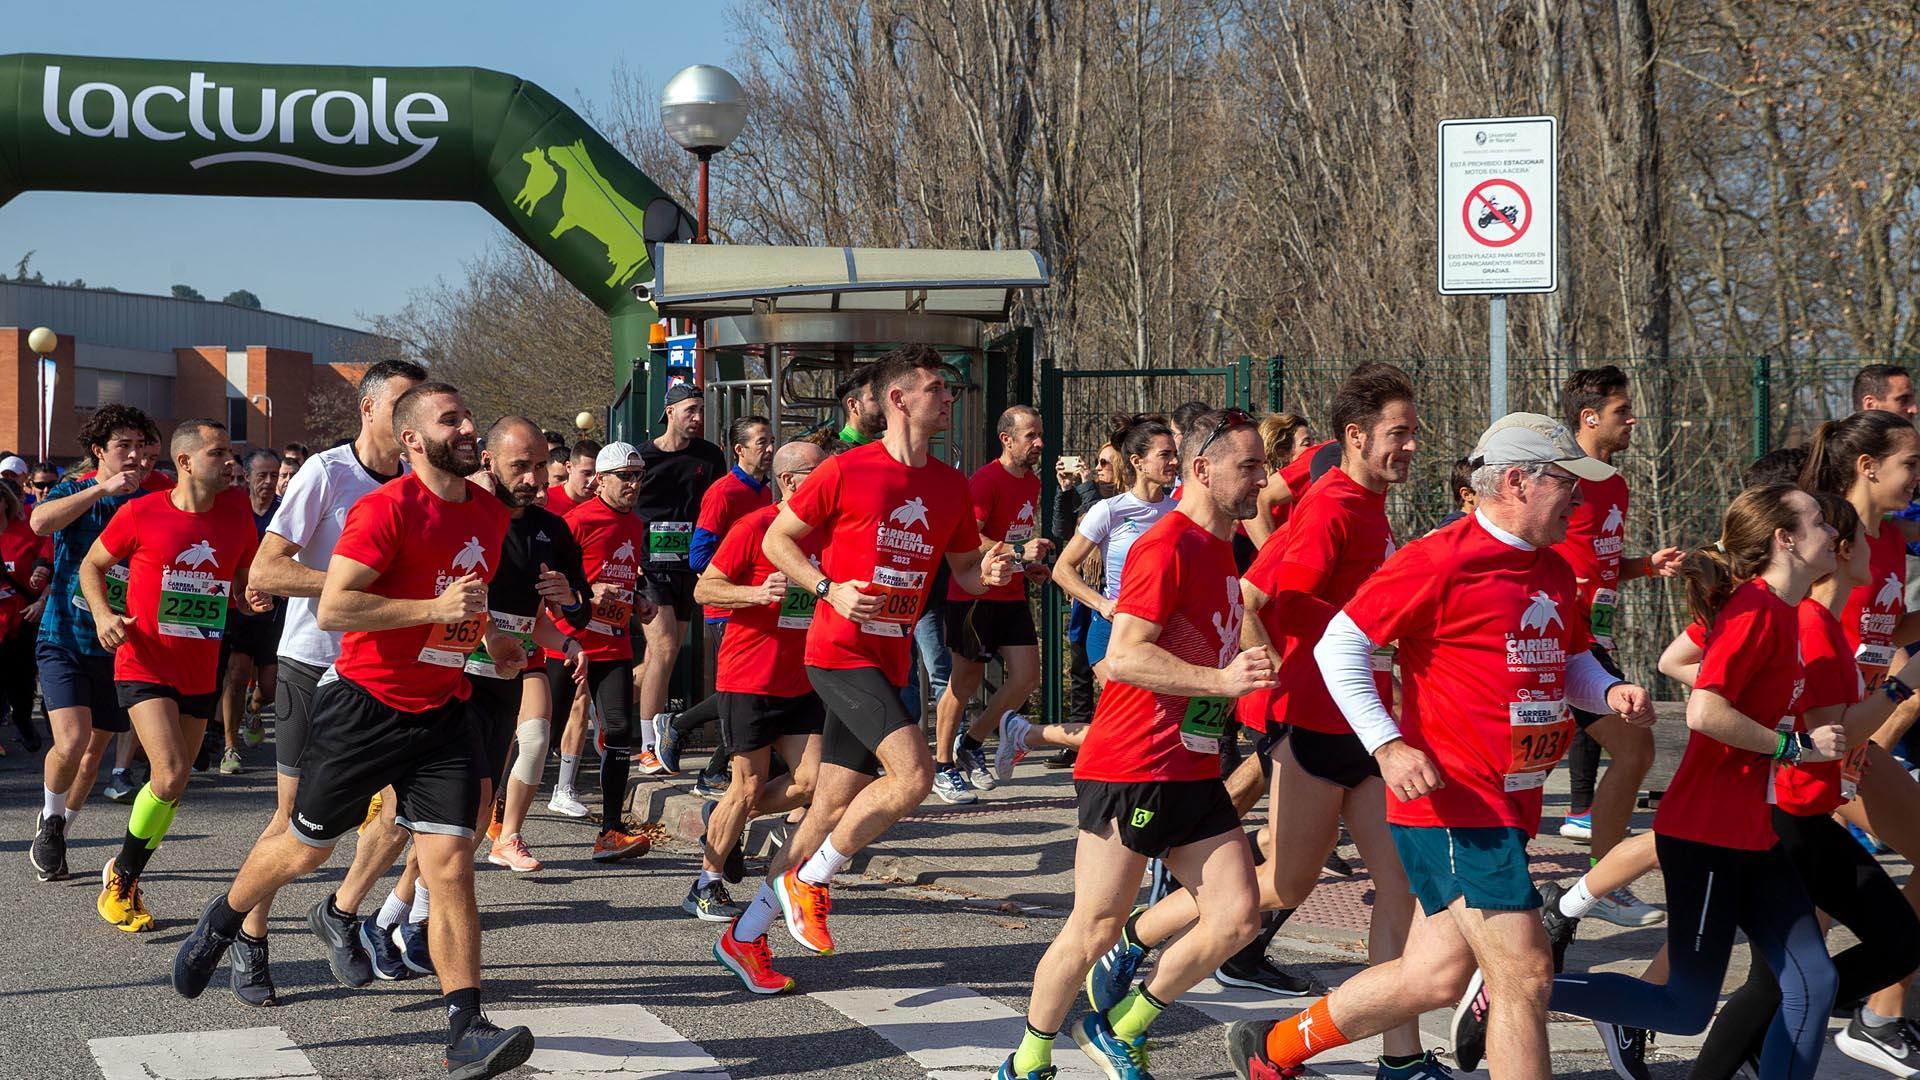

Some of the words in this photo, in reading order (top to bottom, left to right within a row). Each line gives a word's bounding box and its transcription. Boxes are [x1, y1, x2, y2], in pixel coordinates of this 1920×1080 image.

[42, 64, 449, 165] lacturale
[655, 536, 688, 548] 2254
[878, 527, 922, 544] CARRERA
[884, 537, 934, 555] VALIENTES
[163, 570, 214, 580] CARRERA
[164, 597, 220, 620] 2255
[880, 594, 918, 614] 088
[444, 620, 480, 642] 963
[1506, 638, 1559, 652] CARRERA
[1521, 729, 1568, 762] 1031
[298, 812, 323, 831] Kempa
